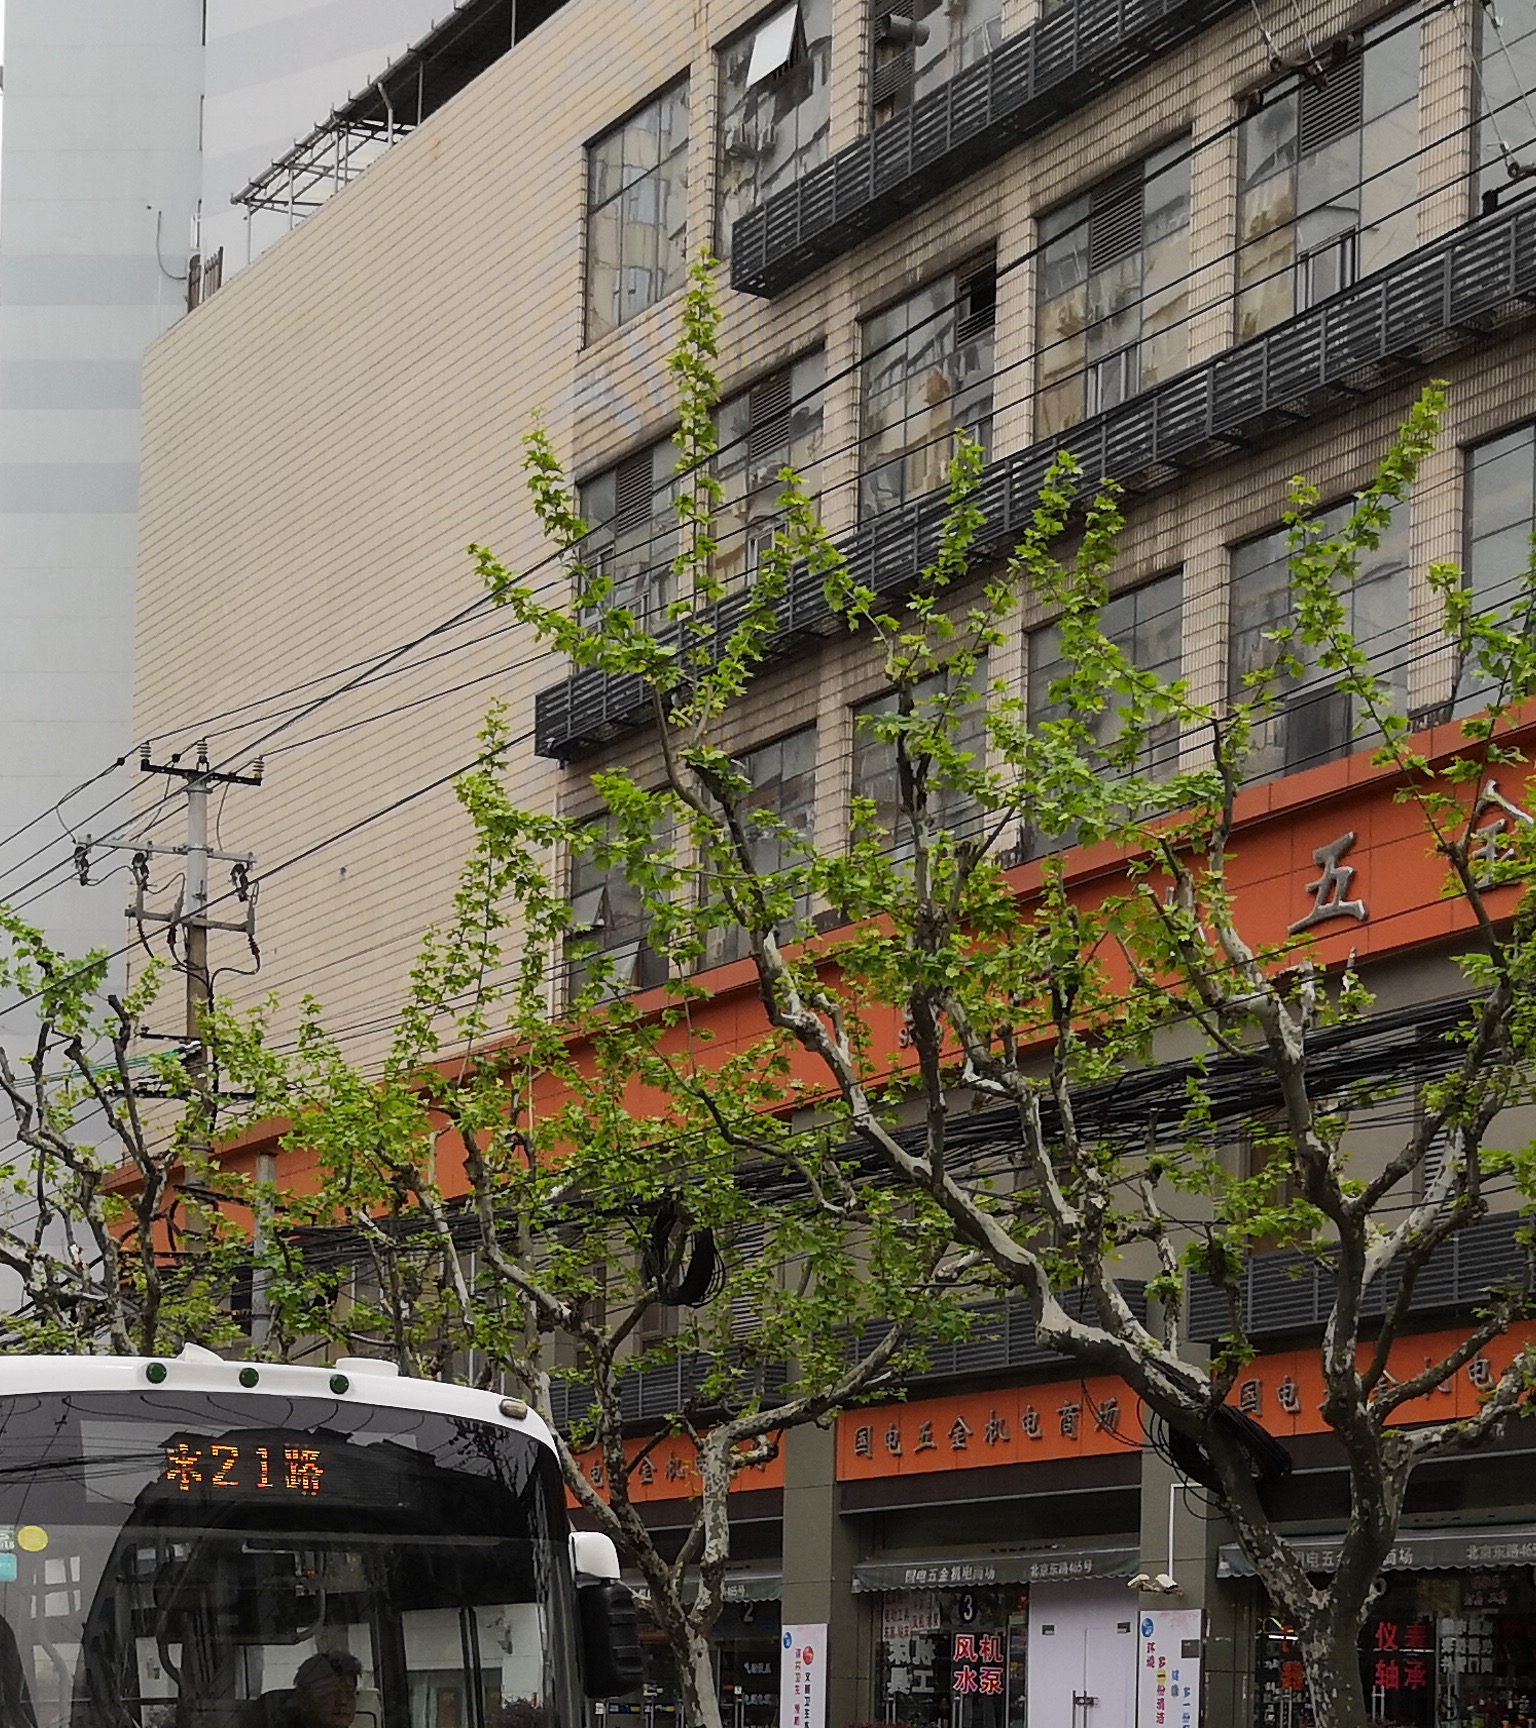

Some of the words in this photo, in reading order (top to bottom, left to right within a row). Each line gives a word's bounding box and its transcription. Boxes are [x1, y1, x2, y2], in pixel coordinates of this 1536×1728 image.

[963, 1594, 974, 1621] 3
[953, 1633, 1005, 1664] 风机
[952, 1665, 1005, 1696] 水泵
